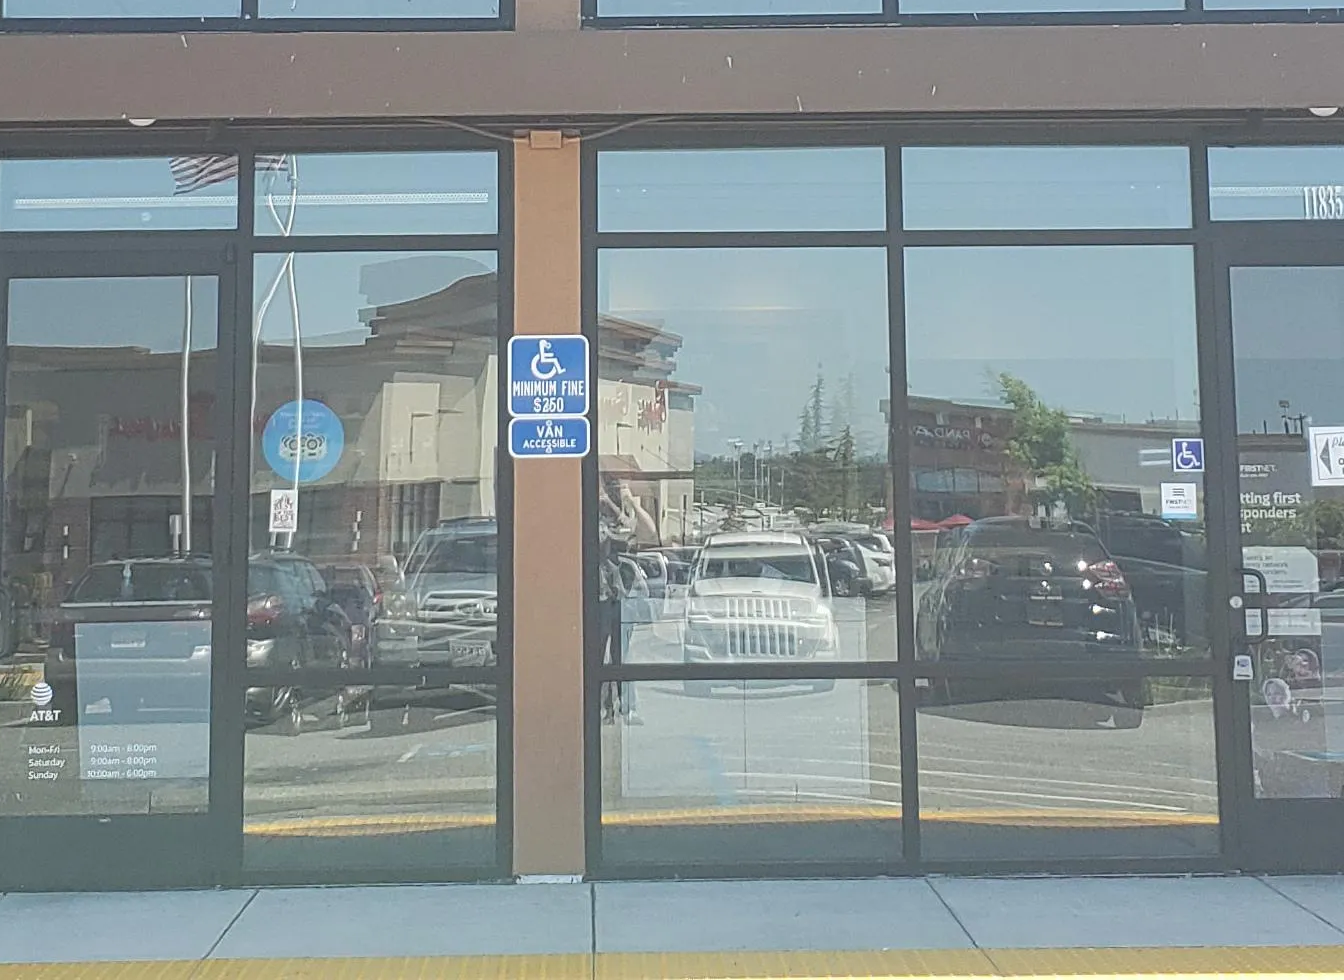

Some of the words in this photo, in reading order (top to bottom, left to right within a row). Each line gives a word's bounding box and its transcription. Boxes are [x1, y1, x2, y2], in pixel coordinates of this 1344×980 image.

[1303, 185, 1343, 219] 11835
[512, 380, 557, 397] MINIMUM
[561, 380, 585, 396] FINE
[533, 397, 564, 413] $250
[536, 425, 563, 438] VAN
[522, 438, 577, 449] ACCESSIBLE
[1273, 492, 1302, 504] first
[29, 709, 62, 722] AT&T
[28, 758, 66, 768] Saturday
[28, 770, 59, 780] Sunday
